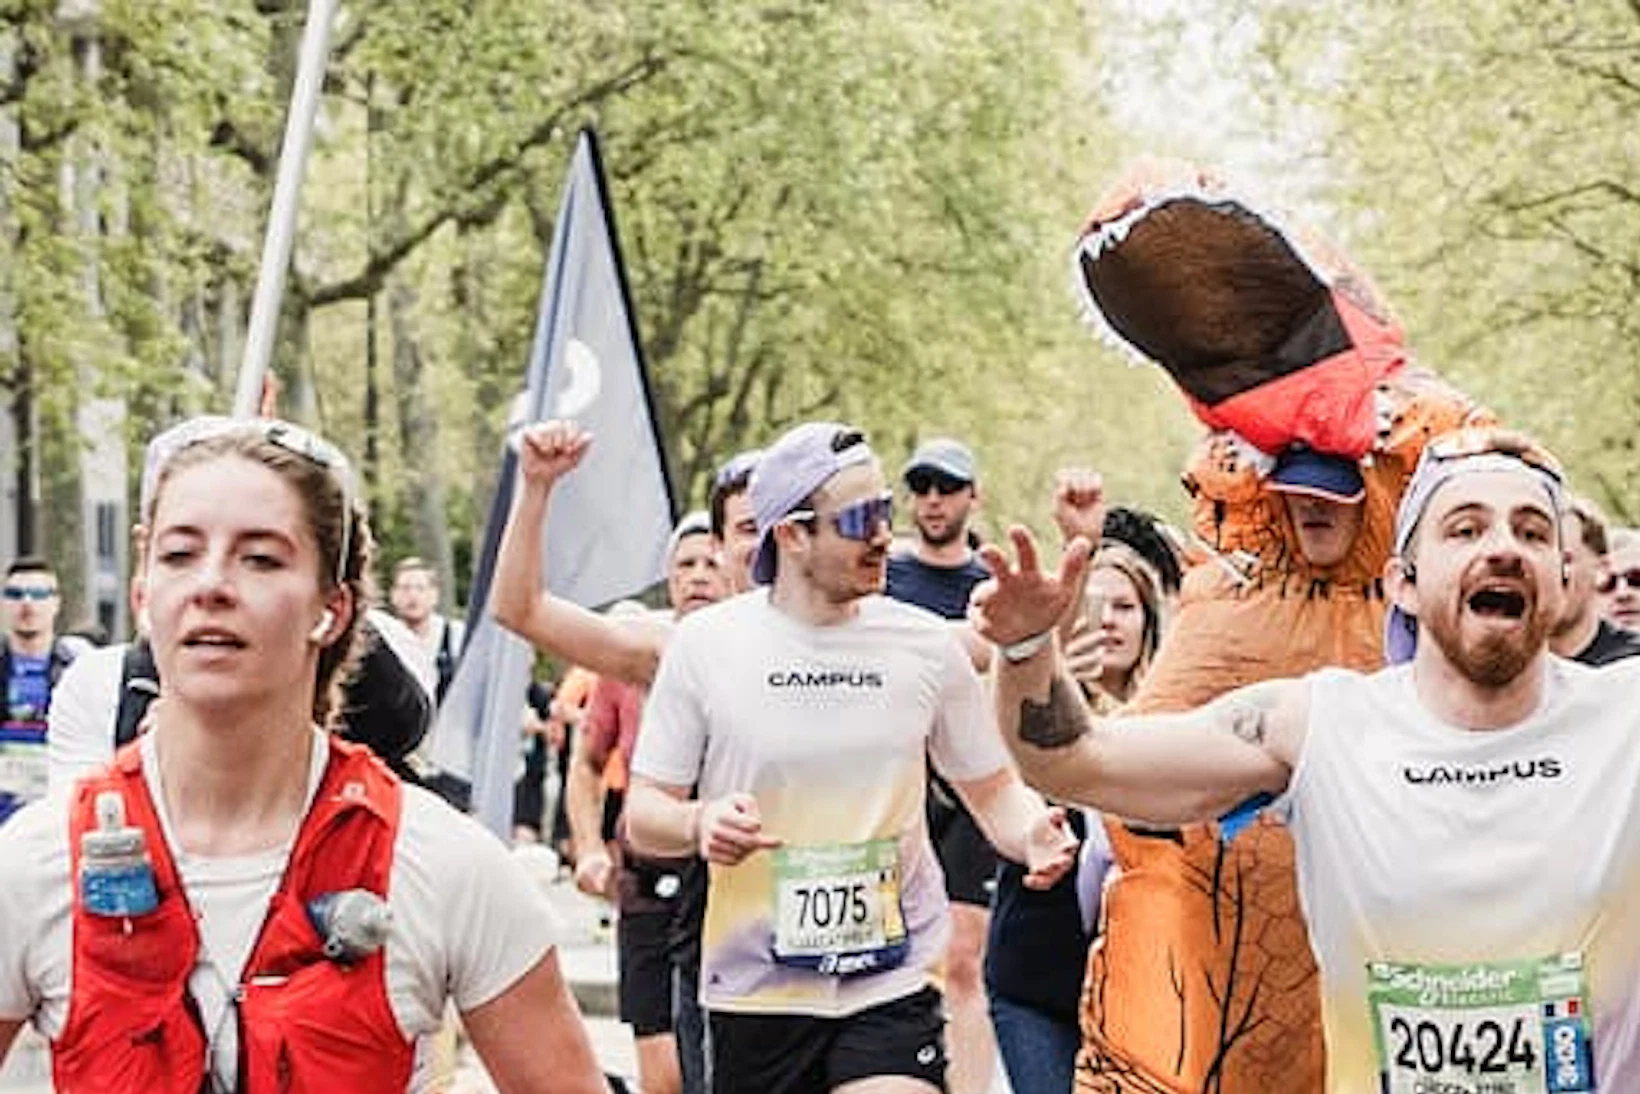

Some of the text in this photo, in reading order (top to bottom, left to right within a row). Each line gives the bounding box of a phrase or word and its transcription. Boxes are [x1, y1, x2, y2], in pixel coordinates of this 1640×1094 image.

[767, 671, 882, 687] CAMPUS
[795, 885, 867, 928] 7075
[1391, 1016, 1535, 1074] 20424
